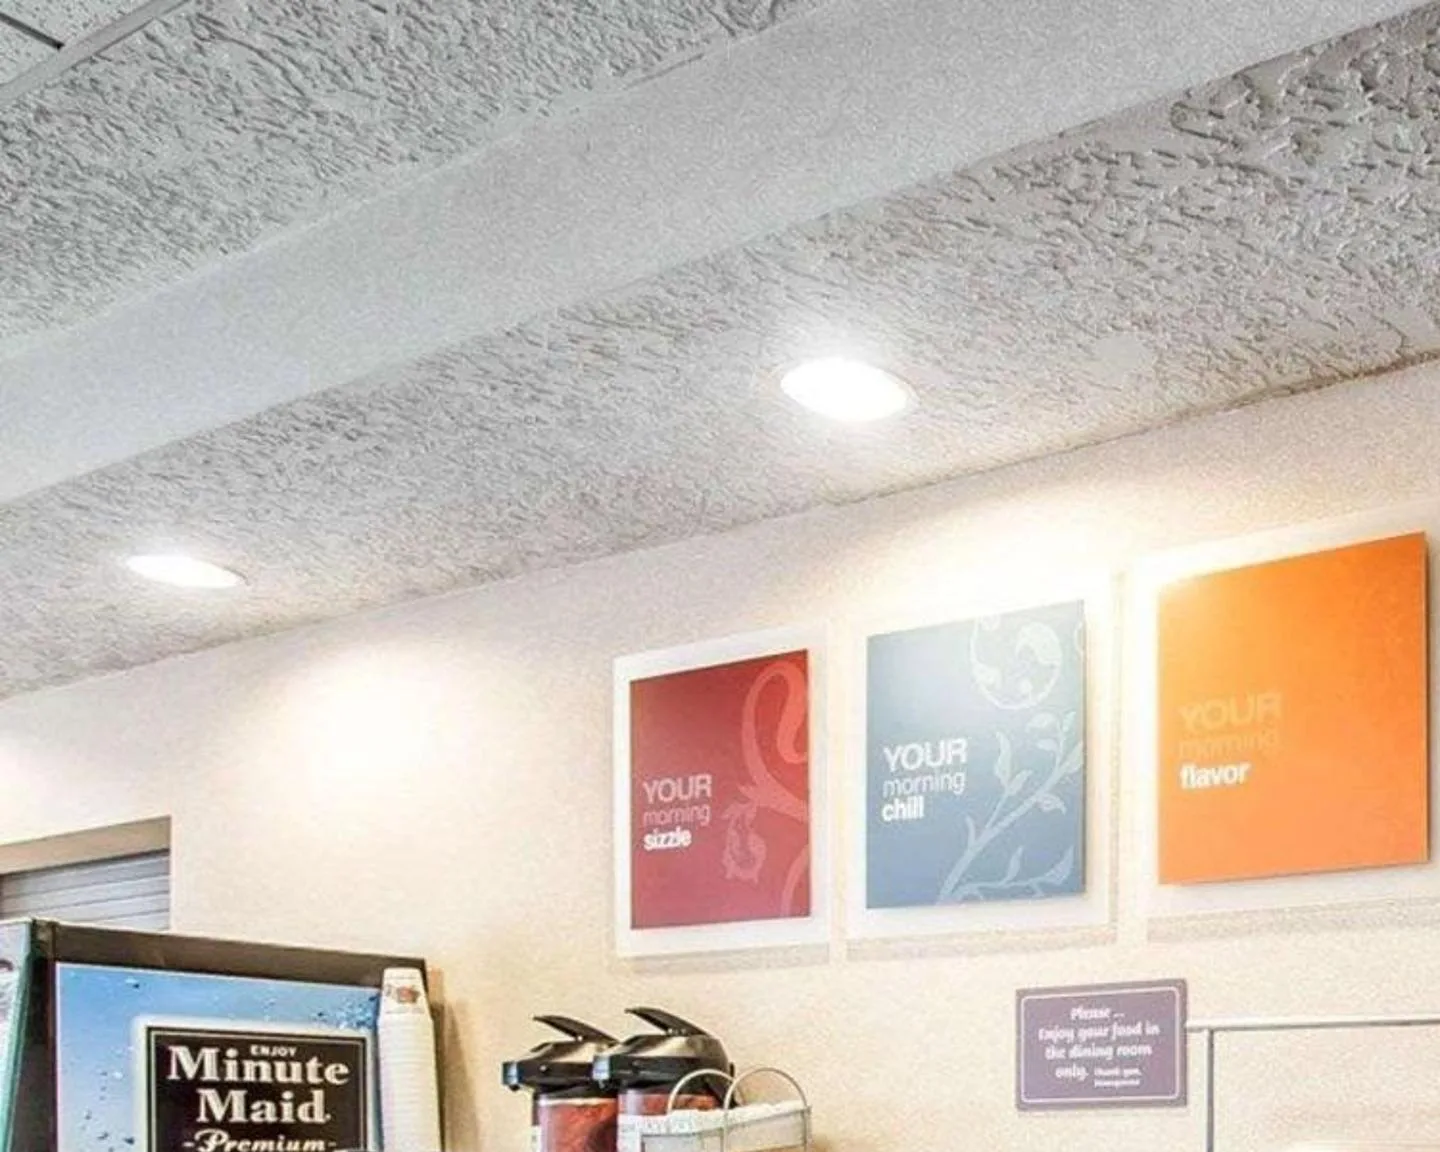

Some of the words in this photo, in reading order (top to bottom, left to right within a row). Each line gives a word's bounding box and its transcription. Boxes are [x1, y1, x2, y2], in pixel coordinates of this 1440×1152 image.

[1177, 691, 1284, 731] YOUR
[882, 738, 968, 773] YOUR
[882, 769, 967, 798] morning
[1180, 760, 1253, 789] flavor
[641, 773, 713, 805] YOUR
[642, 803, 711, 828] morning
[881, 795, 926, 822] chill
[642, 825, 693, 852] sizzle
[1038, 1024, 1075, 1043] Enjoy
[1077, 1025, 1110, 1042] your
[1111, 1021, 1143, 1041] food
[1145, 1020, 1161, 1035] in
[250, 1045, 298, 1057] ENJOY
[1045, 1045, 1066, 1060] the
[1068, 1043, 1114, 1060] dining
[1116, 1044, 1152, 1057] room
[166, 1045, 350, 1086] Minute
